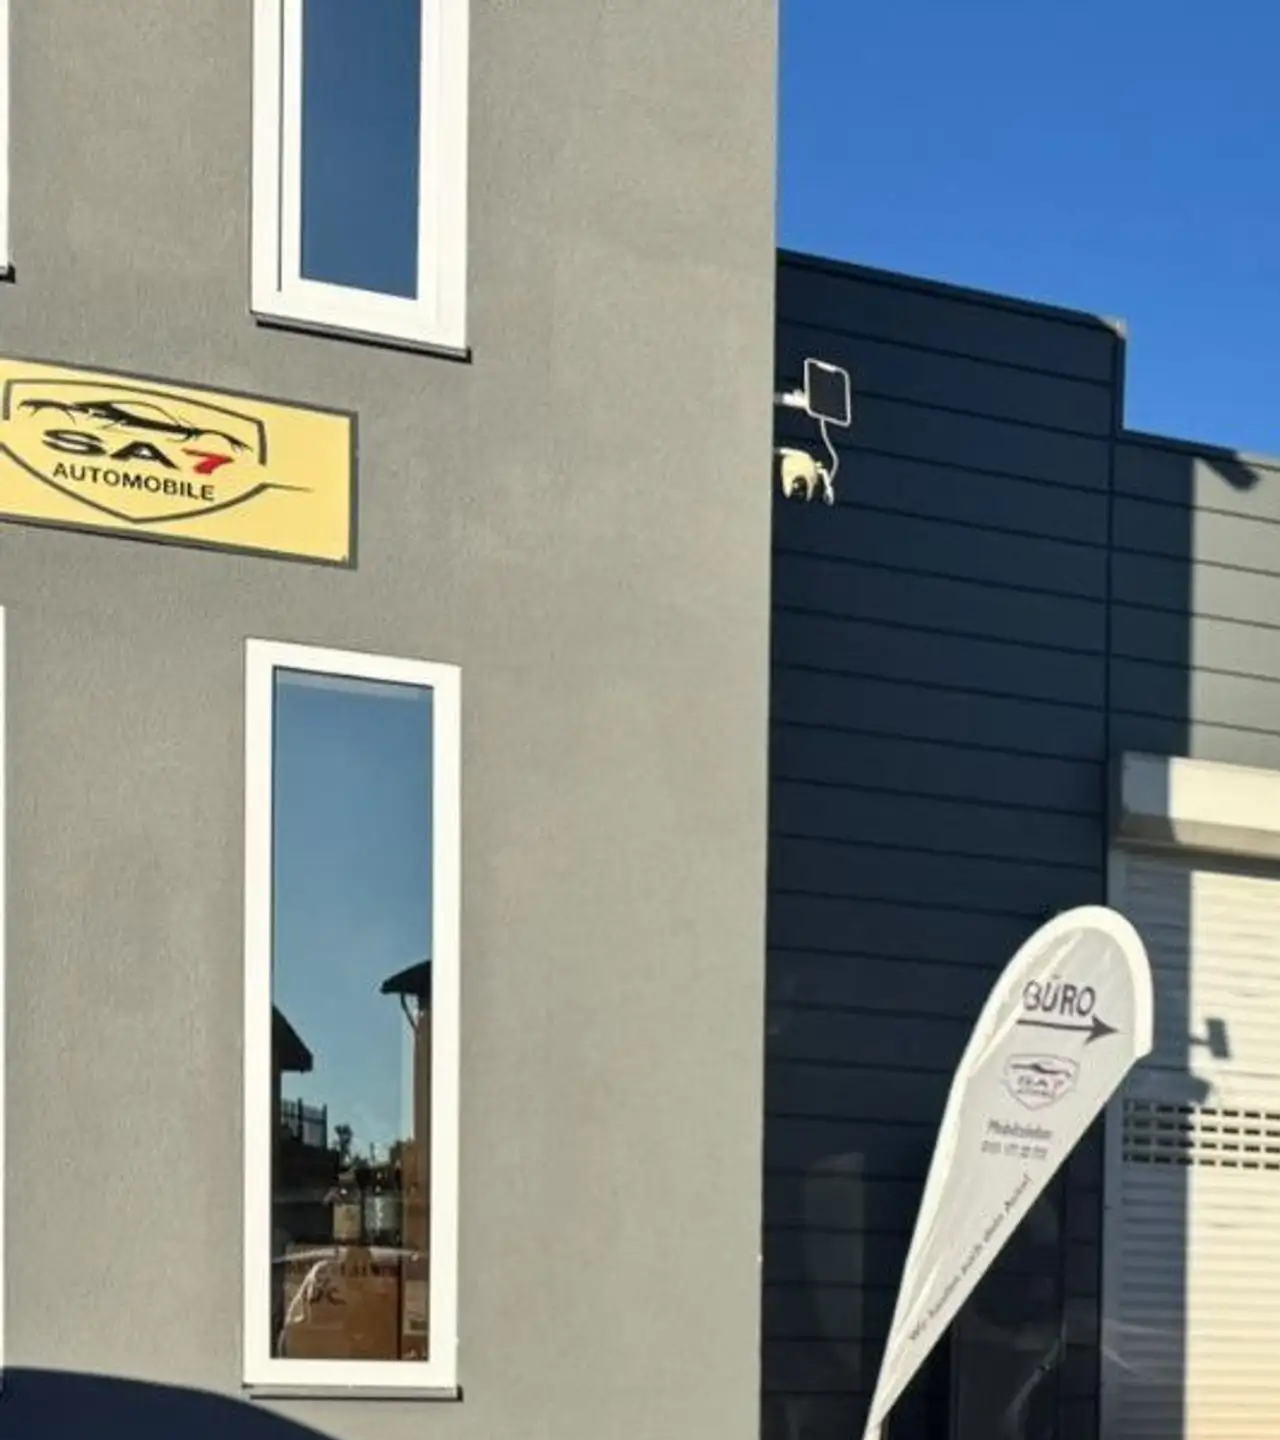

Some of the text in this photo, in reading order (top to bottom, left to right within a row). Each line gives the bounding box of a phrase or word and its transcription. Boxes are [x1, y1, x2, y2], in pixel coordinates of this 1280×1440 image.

[42, 428, 236, 476] SA7
[52, 462, 216, 502] AUTOMOBILE
[1022, 974, 1097, 1017] BÜRO
